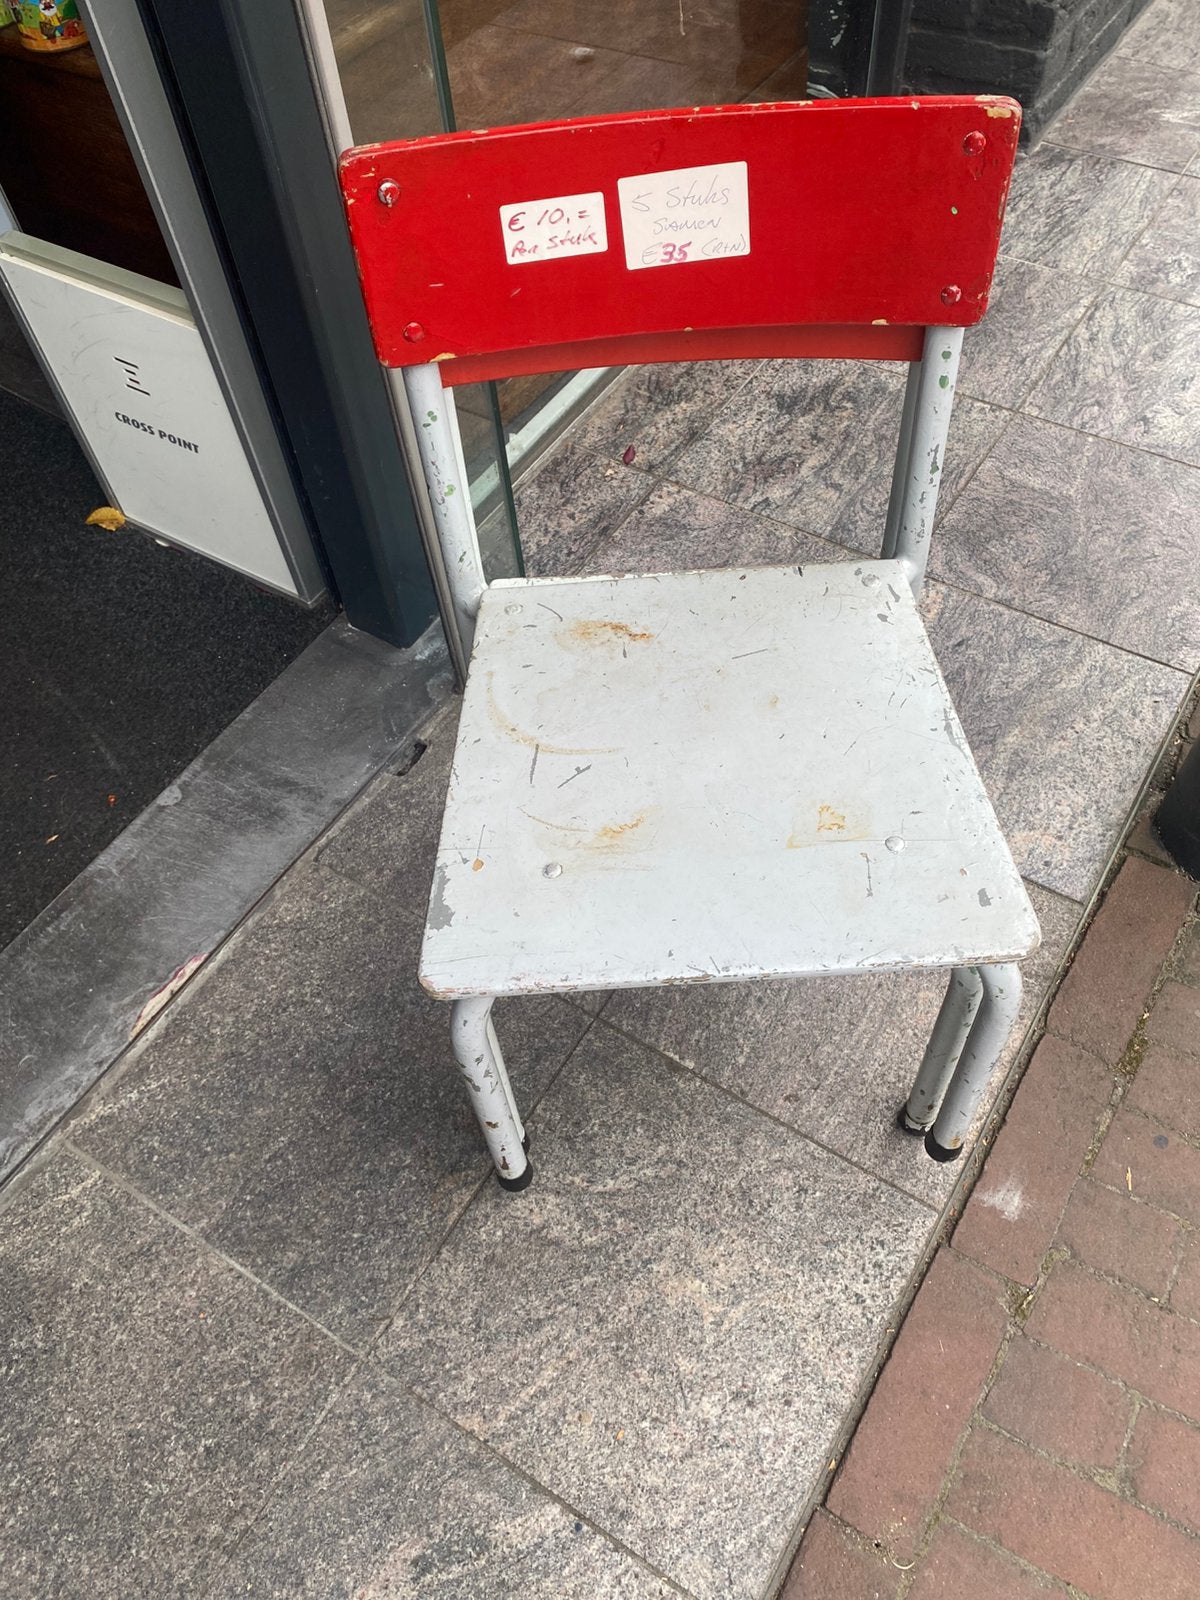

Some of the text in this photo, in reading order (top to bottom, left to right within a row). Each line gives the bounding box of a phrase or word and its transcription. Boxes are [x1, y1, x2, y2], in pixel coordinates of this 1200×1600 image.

[631, 174, 731, 212] 5 Stuks
[508, 211, 526, 232] €
[114, 411, 200, 454] CROSS POINT
